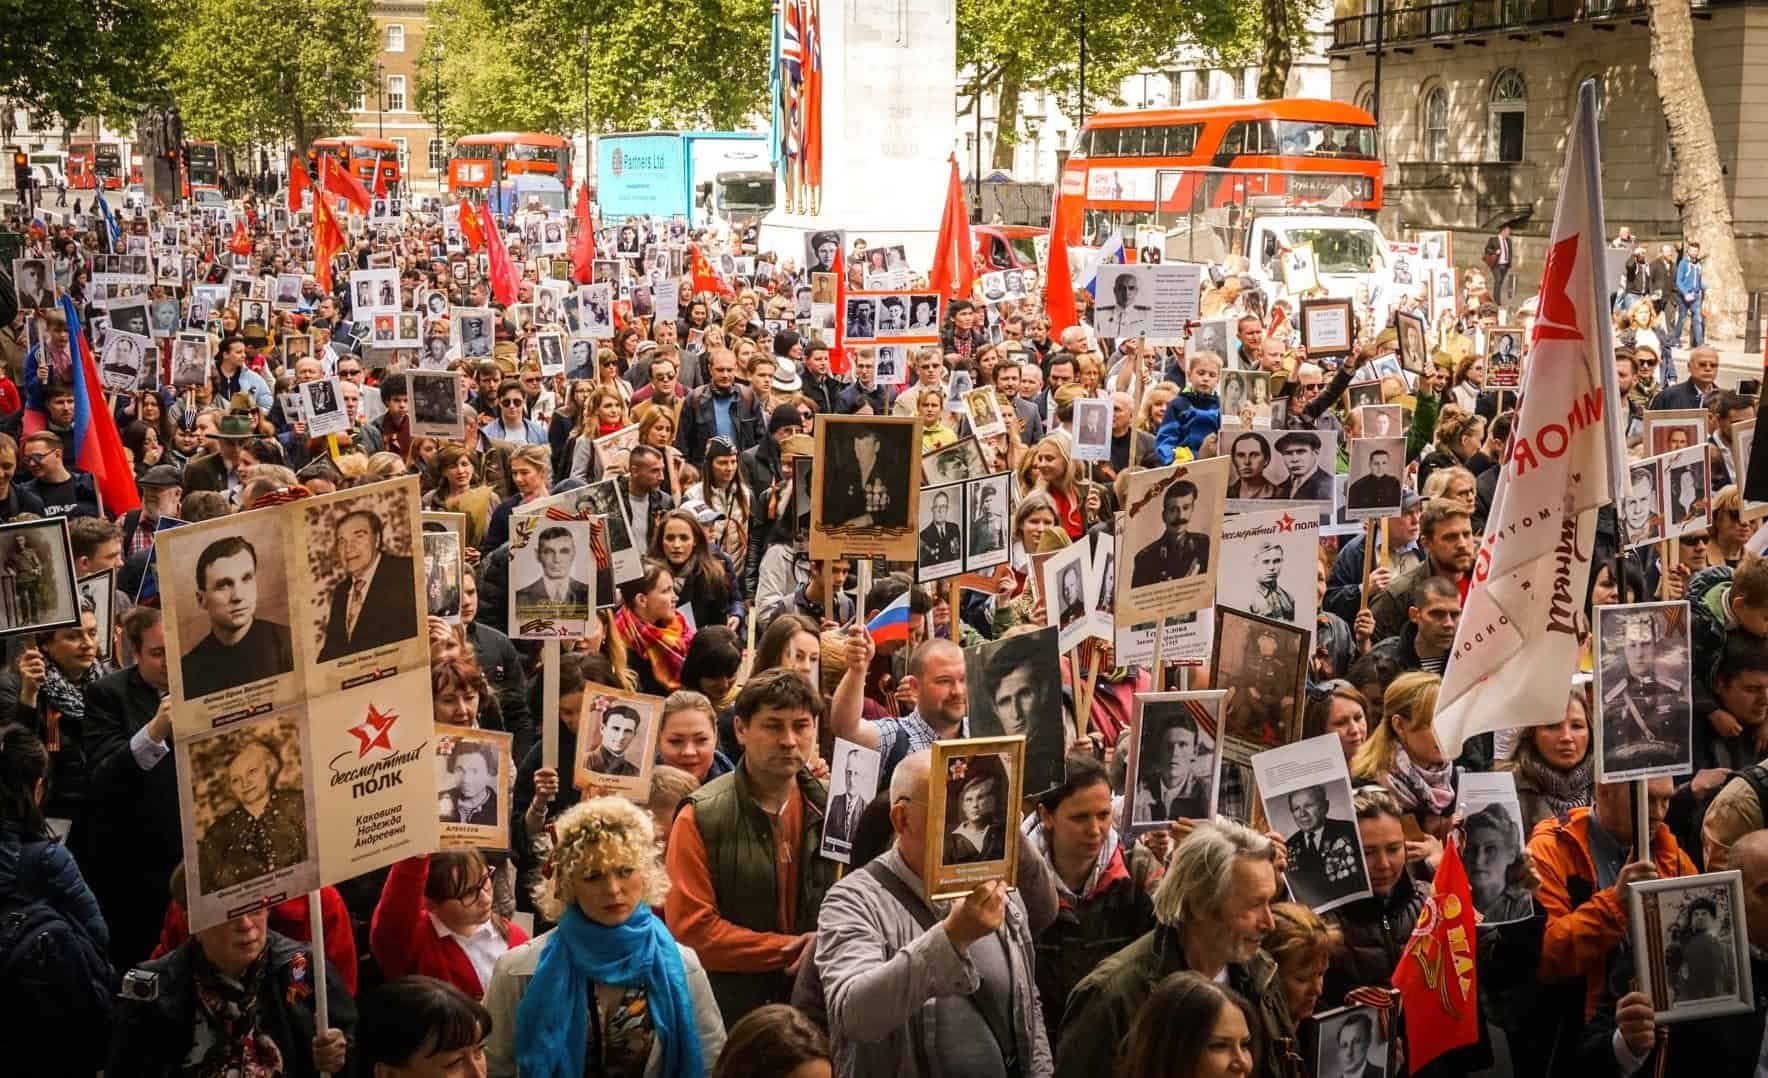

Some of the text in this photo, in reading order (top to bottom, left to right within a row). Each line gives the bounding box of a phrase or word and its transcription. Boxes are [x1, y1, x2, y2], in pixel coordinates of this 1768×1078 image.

[624, 152, 664, 169] Partners Ltd
[1295, 521, 1319, 531] ПОЛК
[352, 770, 403, 798] ПОЛК
[354, 824, 406, 849] Андреевна
[357, 815, 402, 837] Надежда
